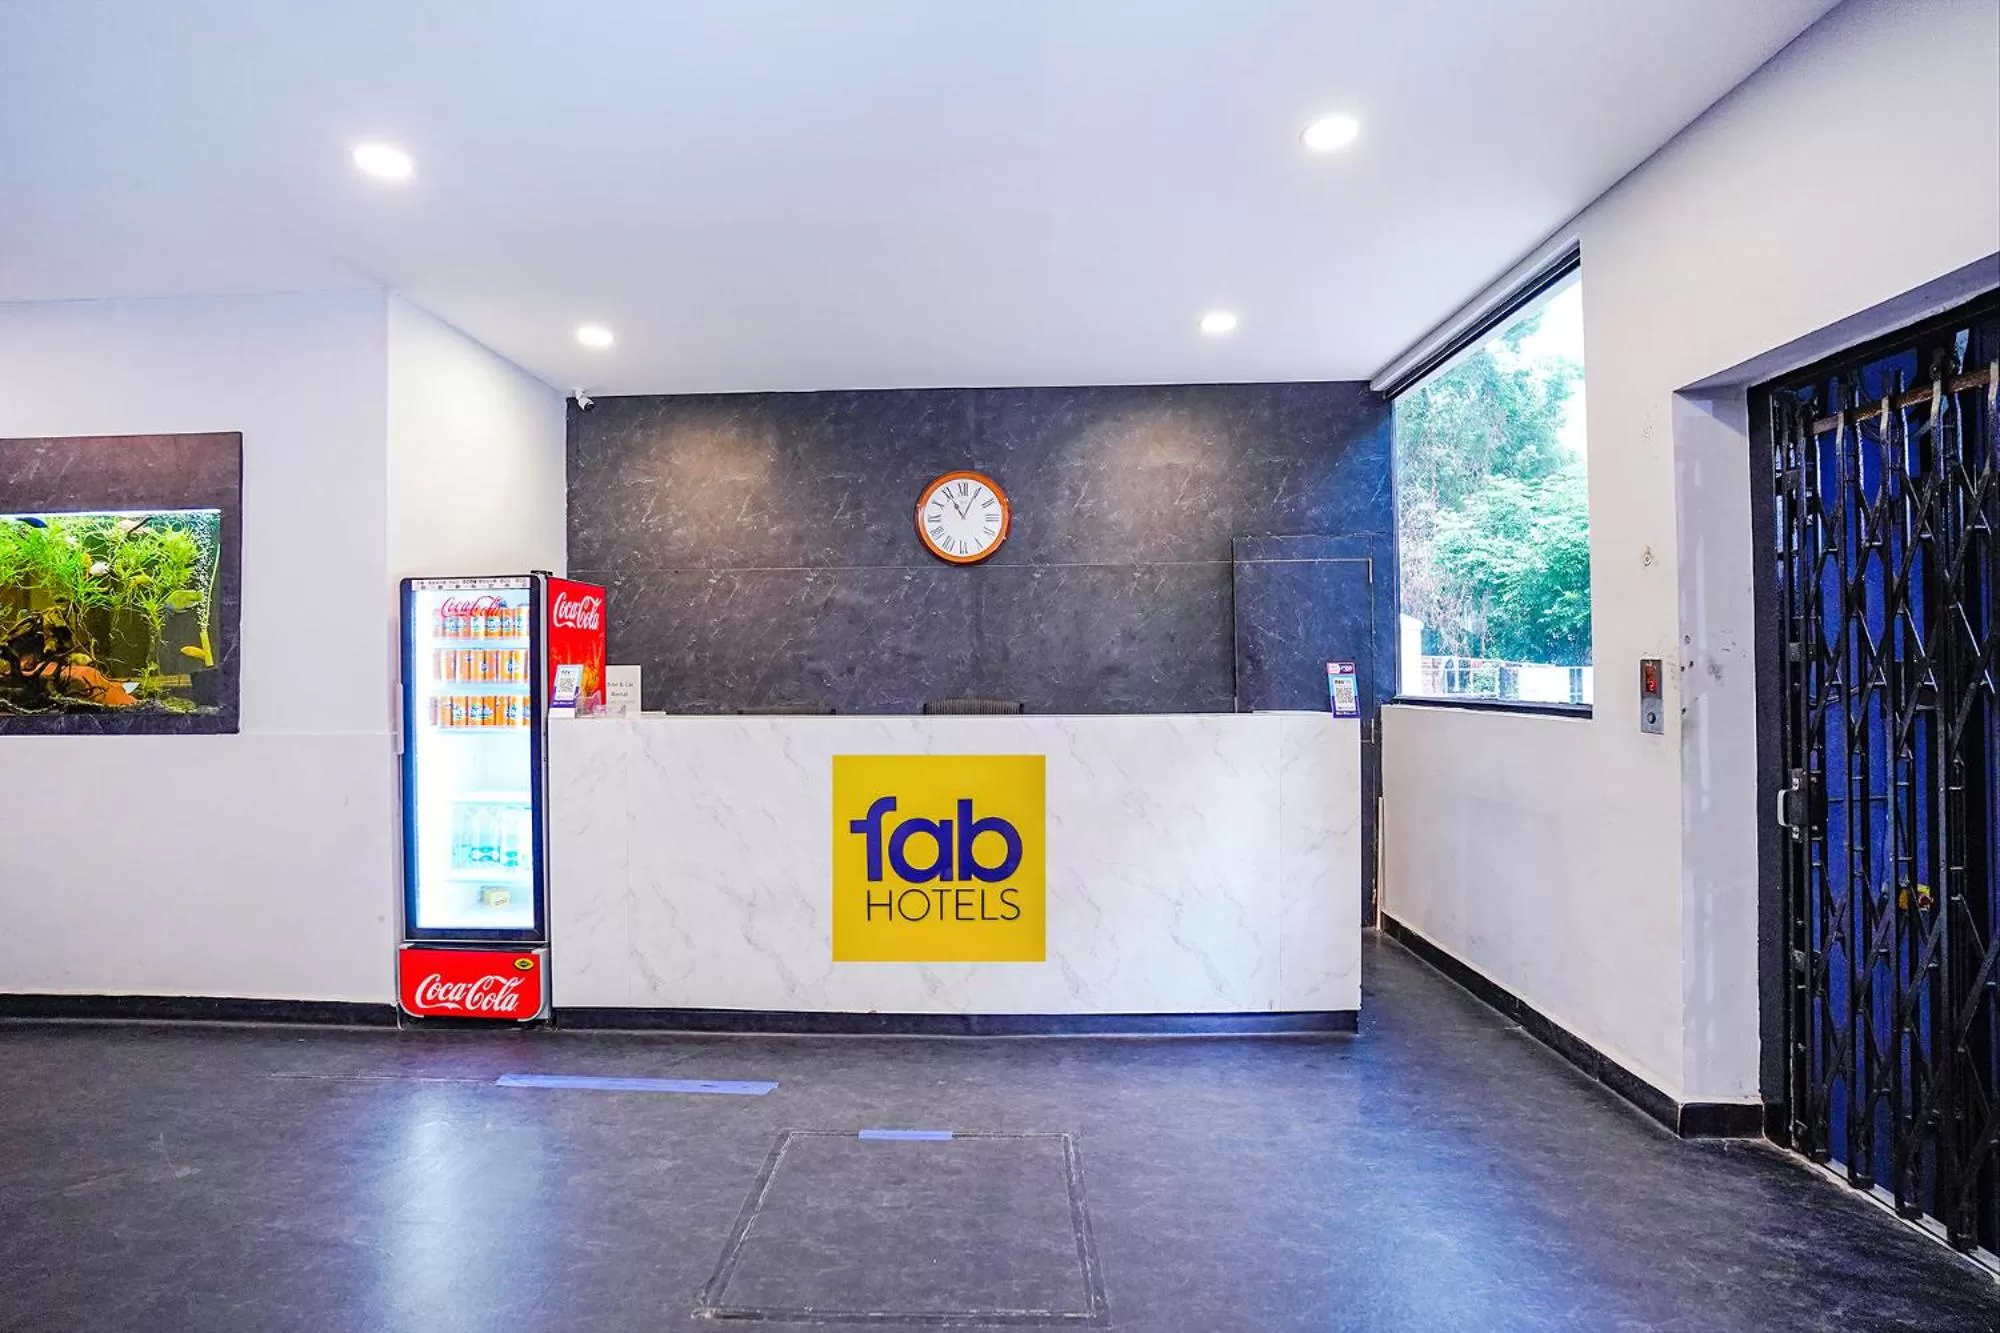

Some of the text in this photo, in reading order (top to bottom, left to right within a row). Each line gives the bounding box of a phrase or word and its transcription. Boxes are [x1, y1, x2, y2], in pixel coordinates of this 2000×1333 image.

[553, 591, 602, 630] Coca-Cola
[850, 796, 1023, 883] fab
[867, 888, 1021, 921] HOTELS
[415, 973, 525, 1012] Coca-Cola
